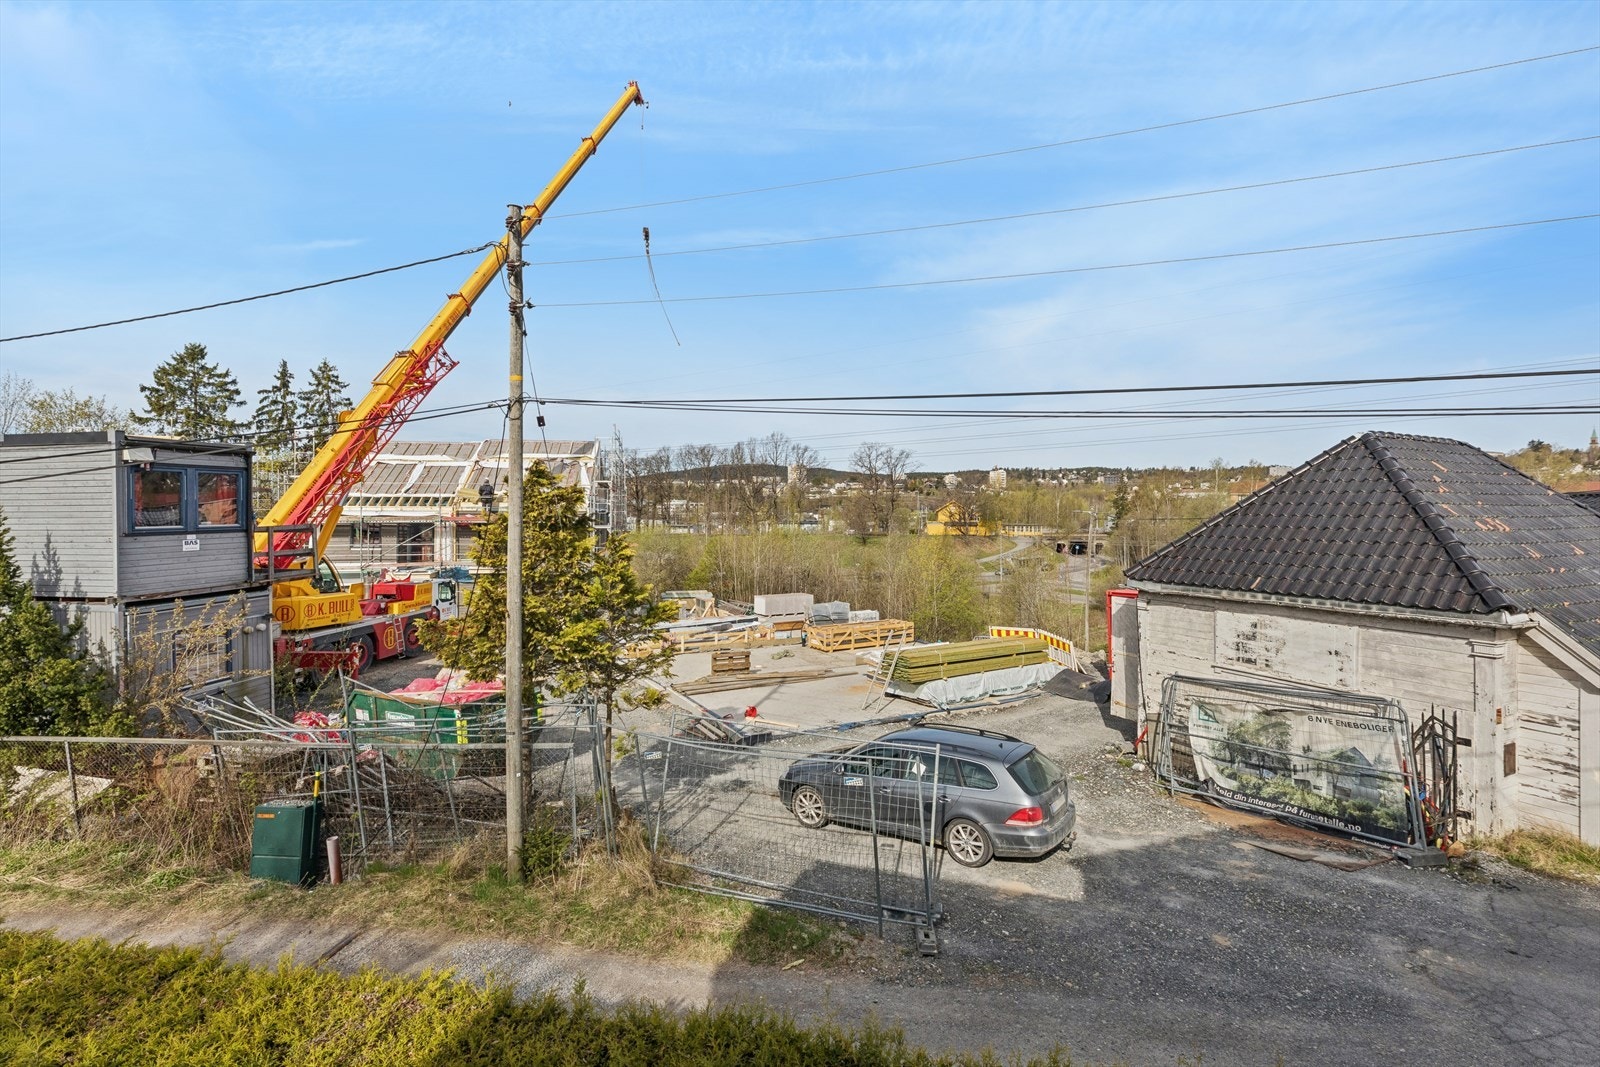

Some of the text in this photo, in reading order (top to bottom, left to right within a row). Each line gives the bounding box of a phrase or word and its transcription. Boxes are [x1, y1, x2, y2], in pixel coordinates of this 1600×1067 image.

[318, 602, 328, 615] K.
[328, 598, 349, 615] BULL
[1315, 715, 1334, 725] NYE
[1336, 719, 1395, 733] ENEBOLIGER
[1213, 783, 1233, 798] Meld
[1234, 793, 1247, 802] din
[1285, 804, 1299, 815] på
